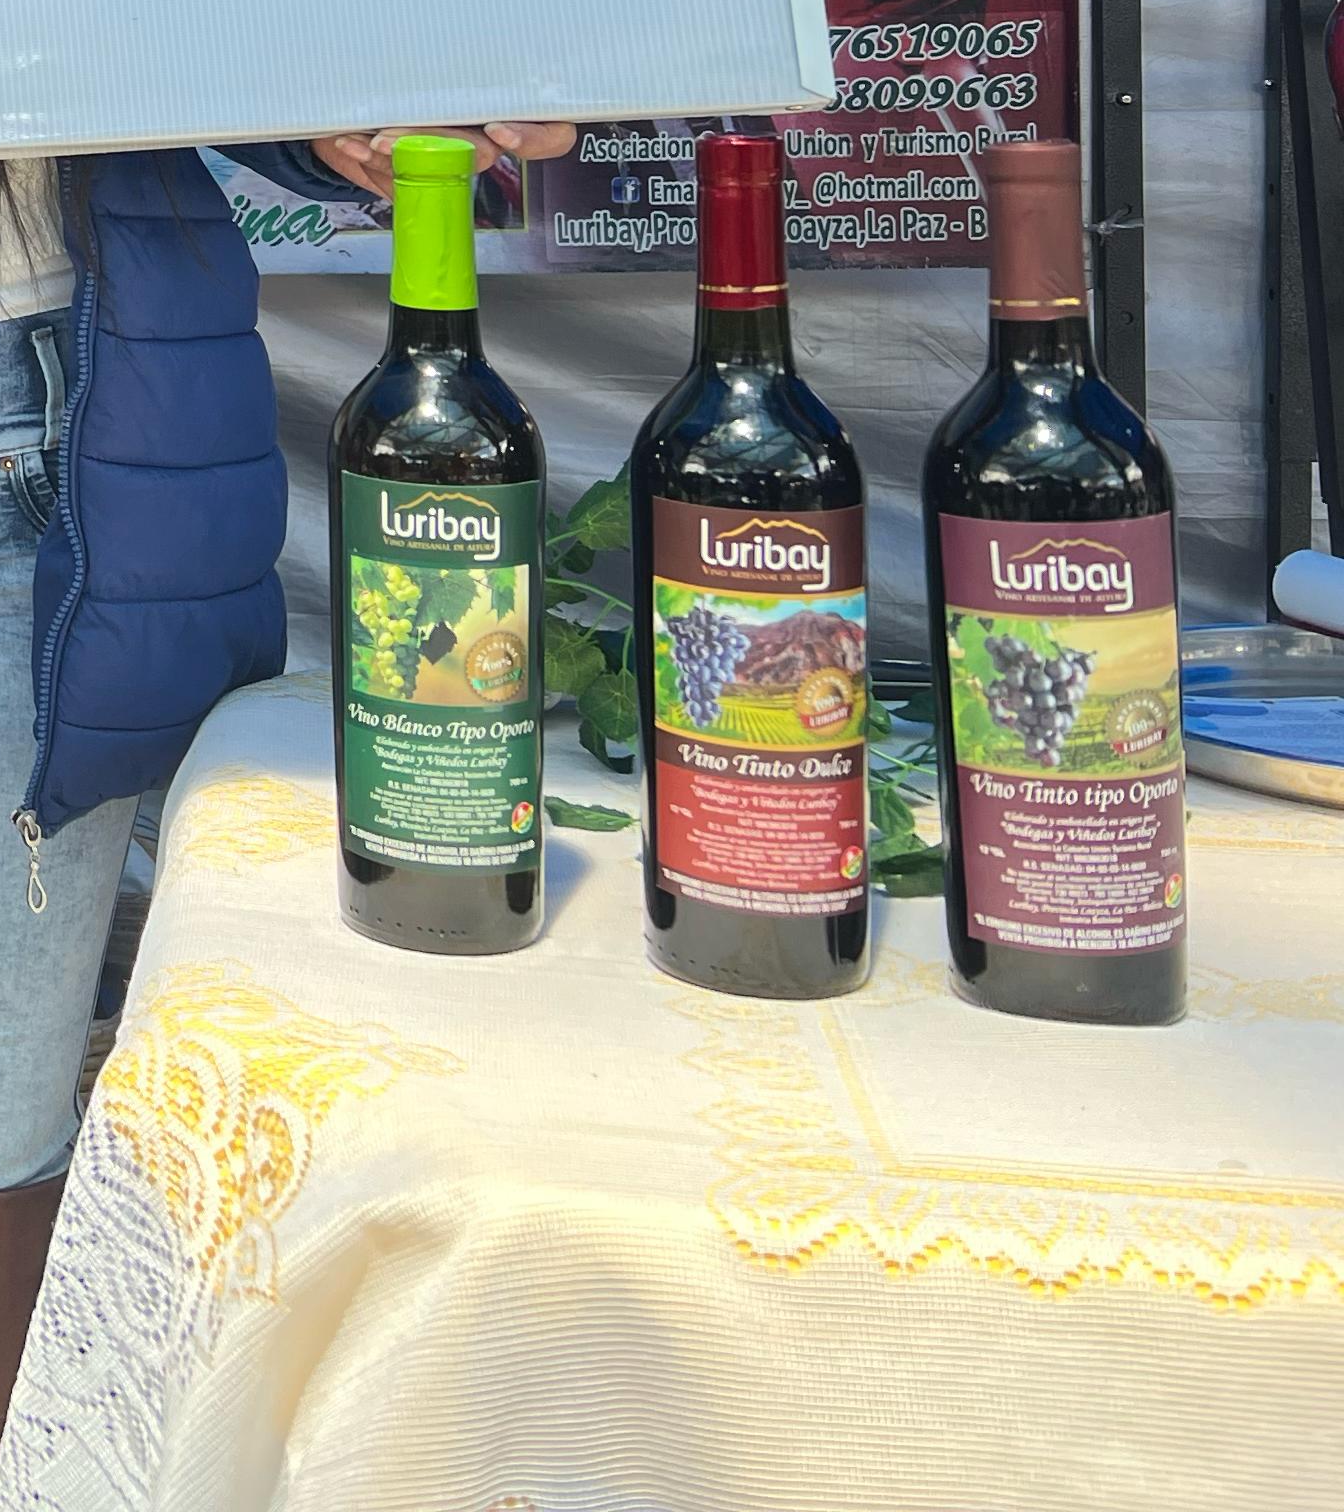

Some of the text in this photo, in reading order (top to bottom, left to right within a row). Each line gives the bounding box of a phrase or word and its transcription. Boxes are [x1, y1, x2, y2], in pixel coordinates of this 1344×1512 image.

[829, 21, 1043, 60] 76519065
[581, 132, 695, 162] Asociacion
[786, 129, 852, 159] Union
[862, 137, 877, 163] y
[881, 128, 970, 156] Turismo
[815, 173, 977, 205] @hotmail.com
[901, 209, 944, 241] Paz
[381, 491, 501, 561] Luribay
[700, 518, 830, 592] Luribay
[989, 540, 1134, 612] Luribay
[348, 703, 379, 727] Vino
[382, 714, 442, 738] Blanco
[447, 721, 486, 744] Tipo
[490, 719, 534, 743] Oporto
[677, 743, 729, 771] Vino
[732, 754, 795, 778] Tinto
[970, 773, 1178, 812] Vino Tinto tipo Oporto
